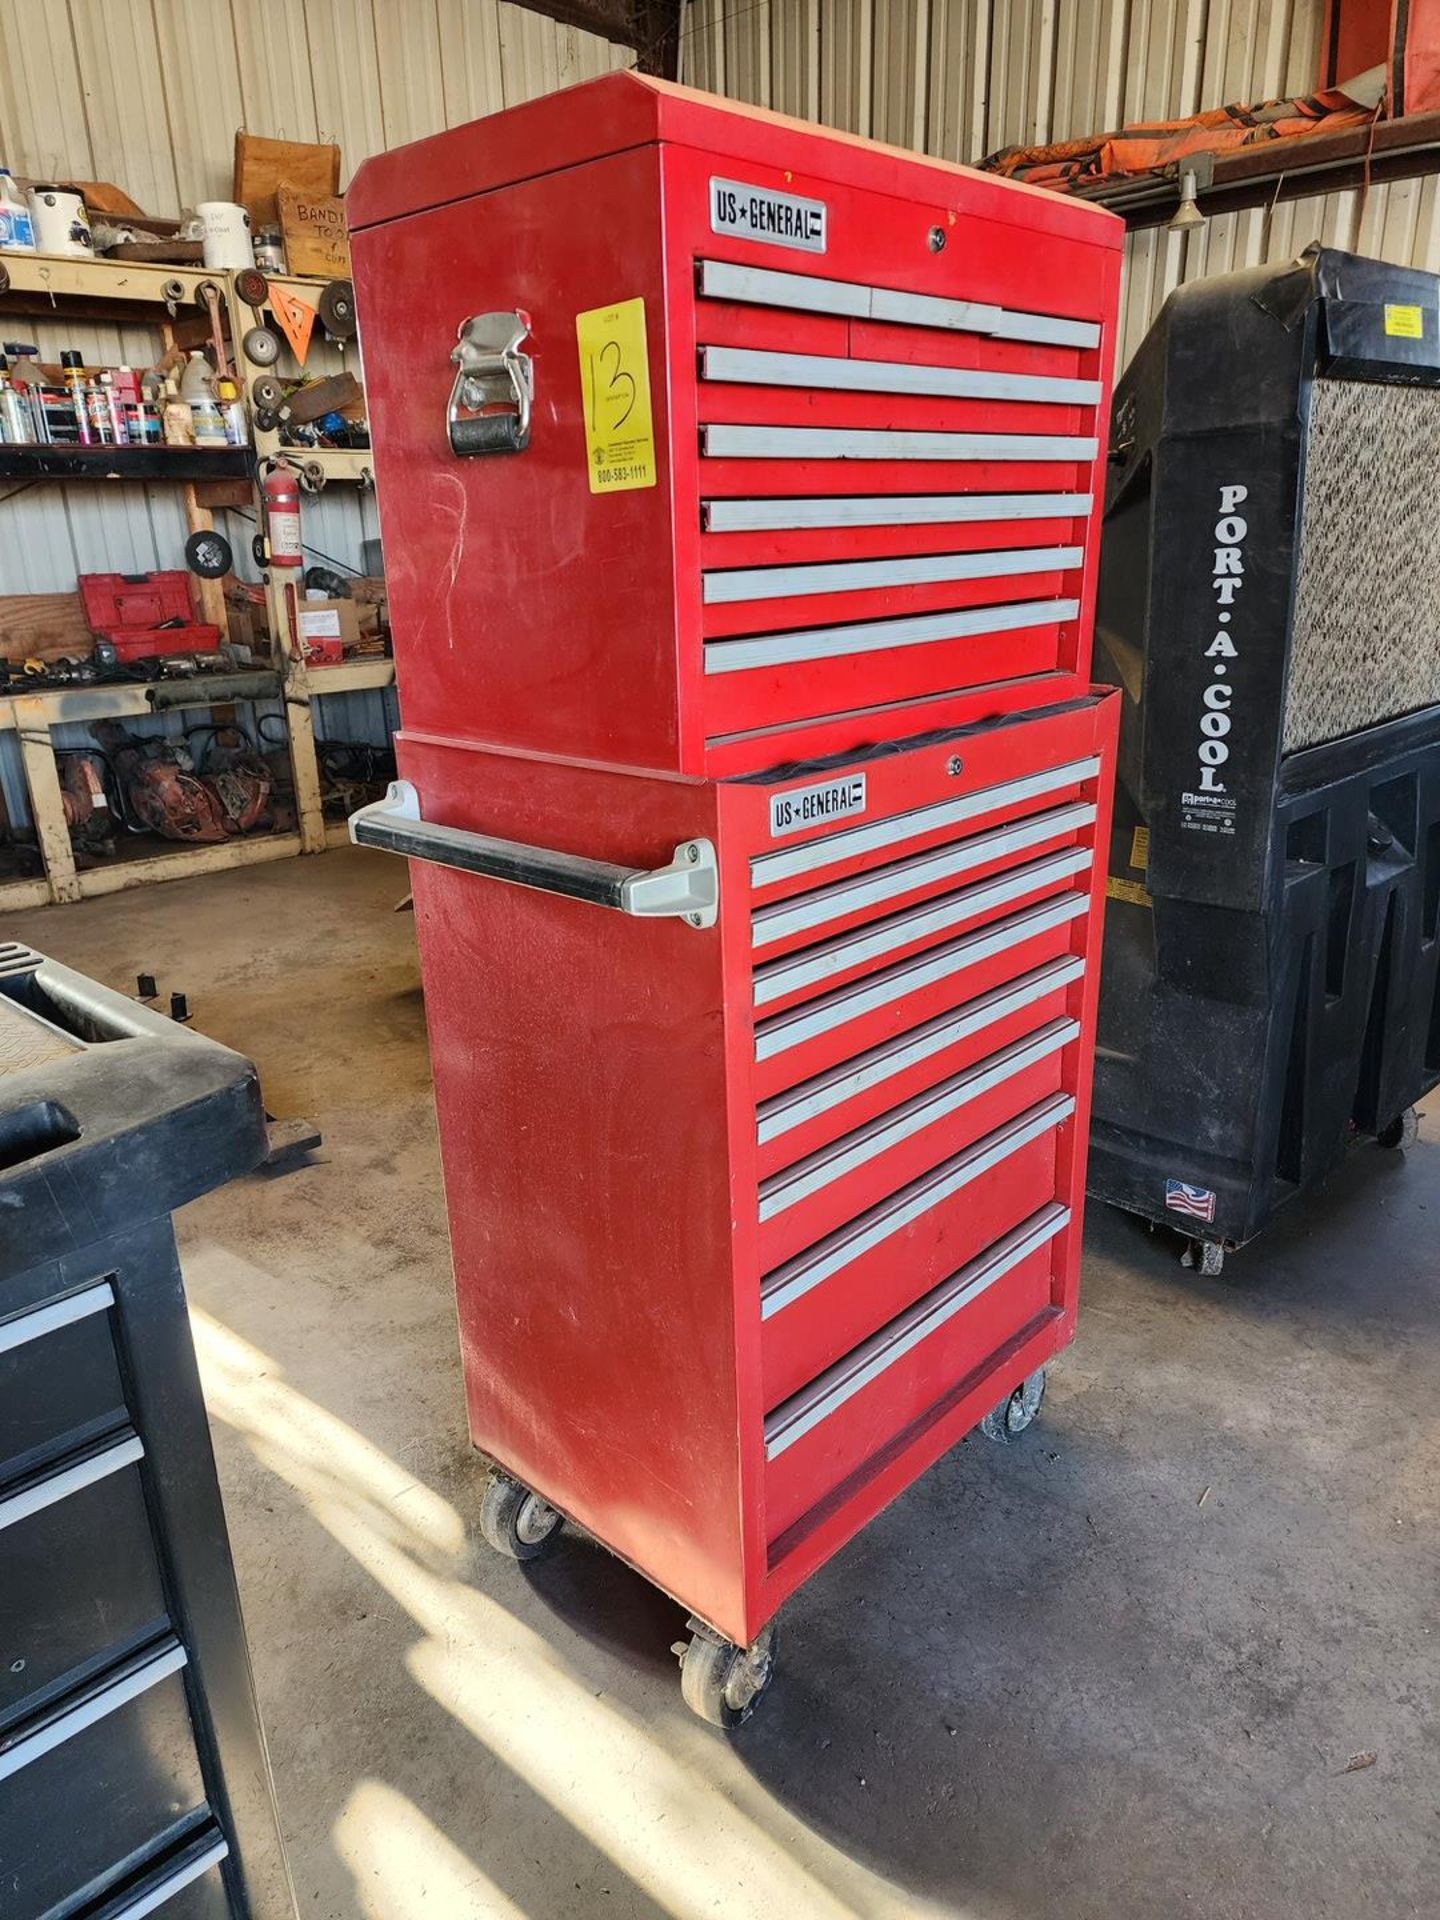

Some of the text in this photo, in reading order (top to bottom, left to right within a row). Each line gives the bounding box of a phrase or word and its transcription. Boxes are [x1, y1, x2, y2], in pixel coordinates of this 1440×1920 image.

[717, 190, 811, 240] US GENERAL
[589, 341, 636, 432] 13
[776, 785, 854, 828] US GENERAL
